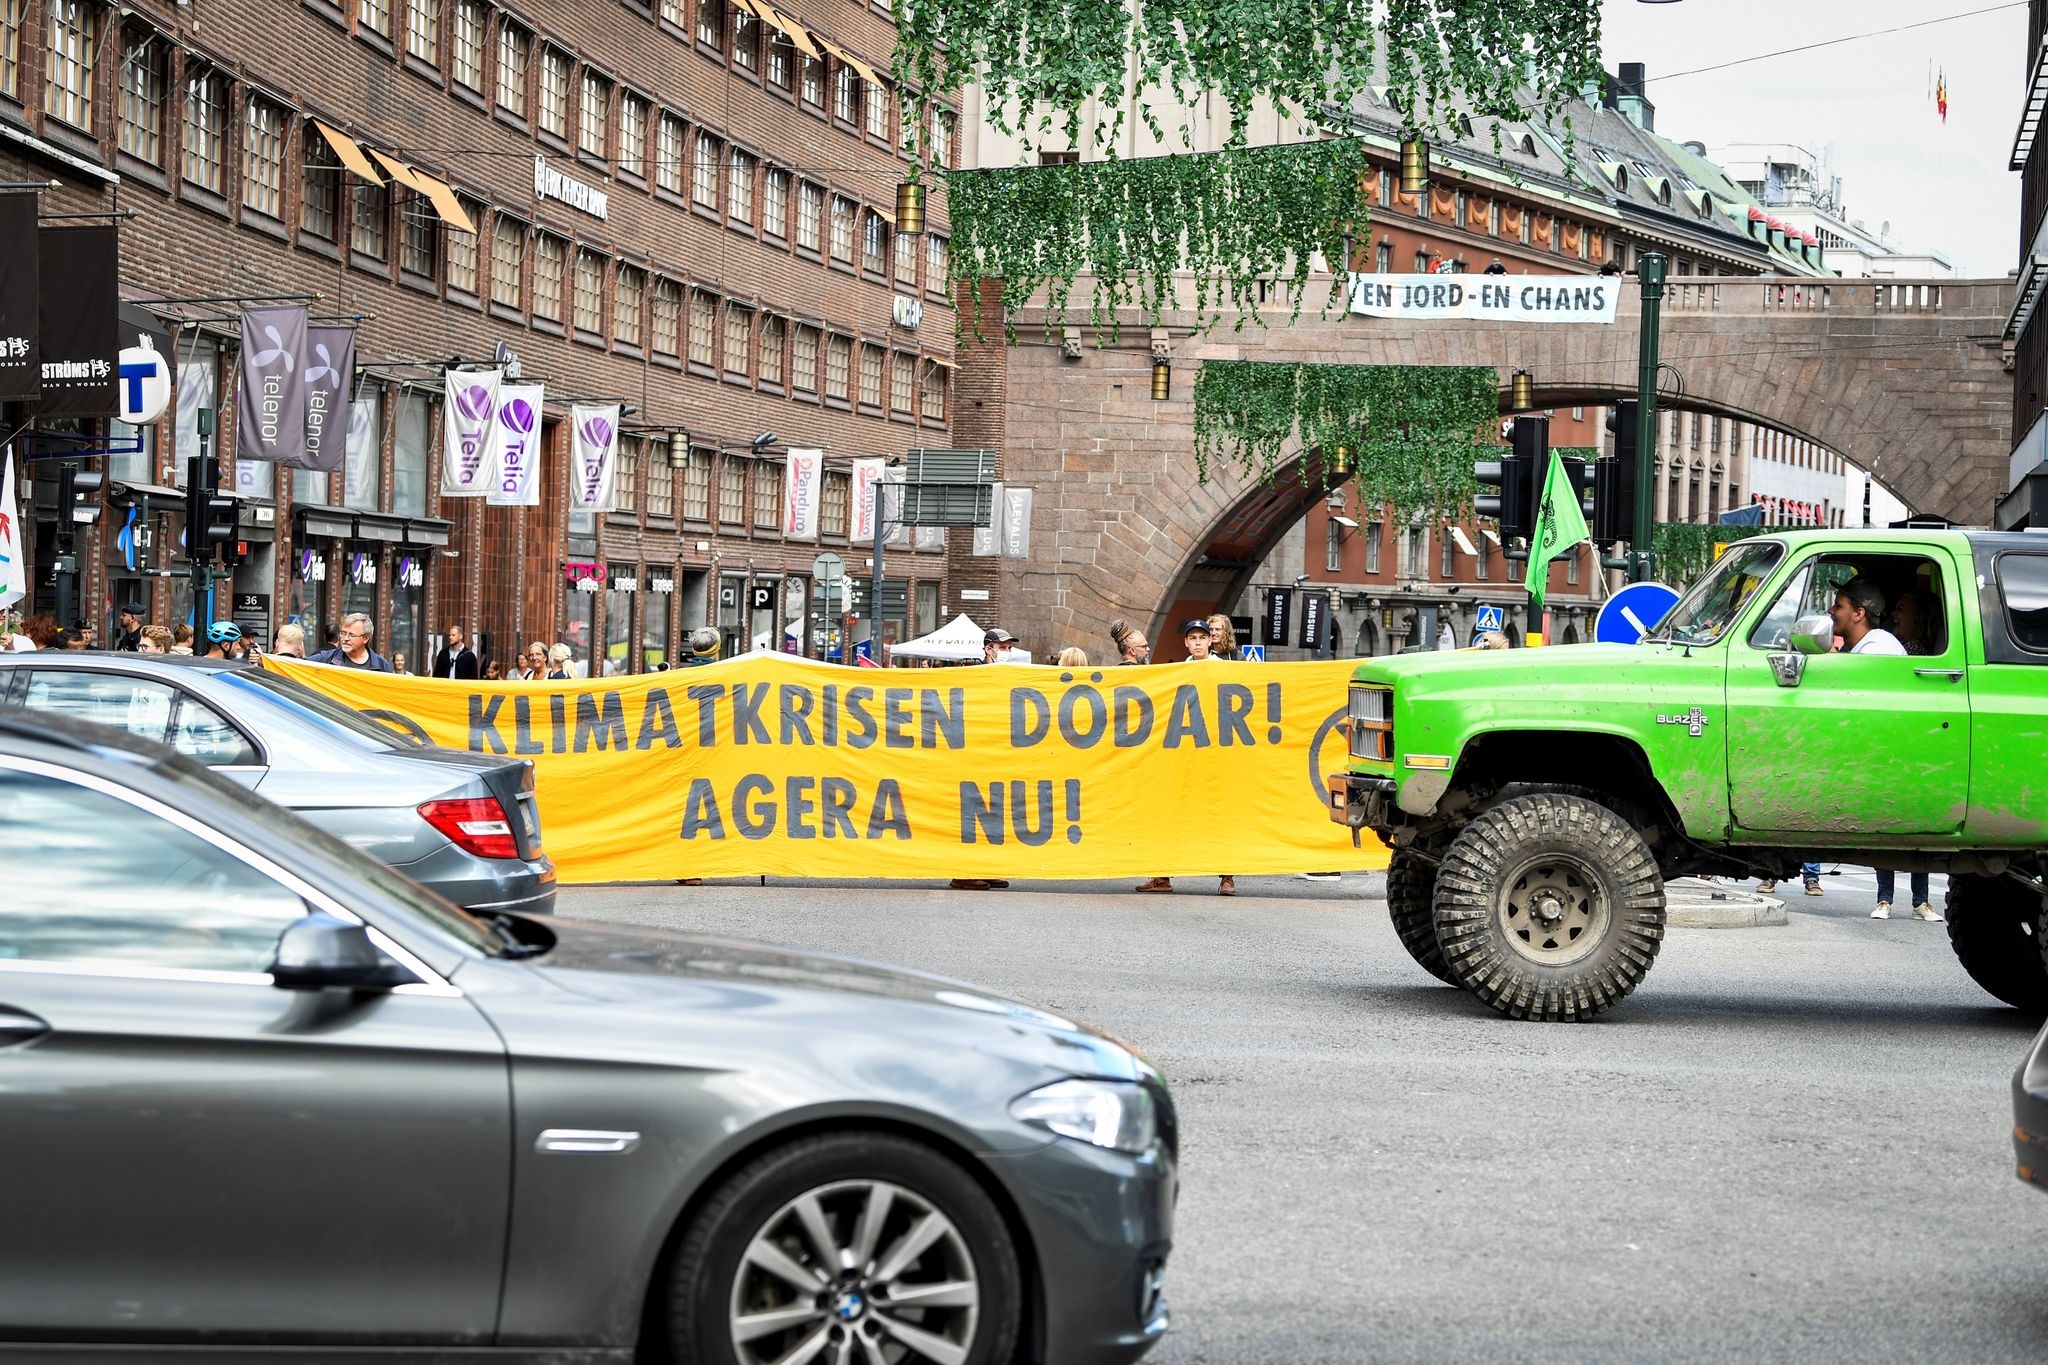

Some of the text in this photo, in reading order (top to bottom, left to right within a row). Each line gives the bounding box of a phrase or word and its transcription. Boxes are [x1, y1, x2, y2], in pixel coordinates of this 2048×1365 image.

[1363, 282, 1393, 307] EN
[1520, 285, 1606, 311] CHANS
[41, 360, 90, 379] STRÖMS
[119, 362, 157, 414] T
[261, 374, 285, 446] telenor
[305, 389, 329, 457] telenor
[460, 427, 482, 484] Telia
[502, 439, 525, 492] Telia
[584, 453, 603, 502] Telia
[262, 510, 270, 518] 36
[795, 470, 812, 532] Panduro
[1009, 494, 1024, 555] ALEWALDS
[244, 595, 258, 606] 36
[1272, 594, 1284, 640] SAMSUNG
[1305, 598, 1318, 643] SAMSUNG
[468, 671, 1282, 755] KLIMATKRISEN DÖDAR!
[1656, 714, 1709, 725] BLAZER
[680, 773, 1082, 846] AGERA NU!
